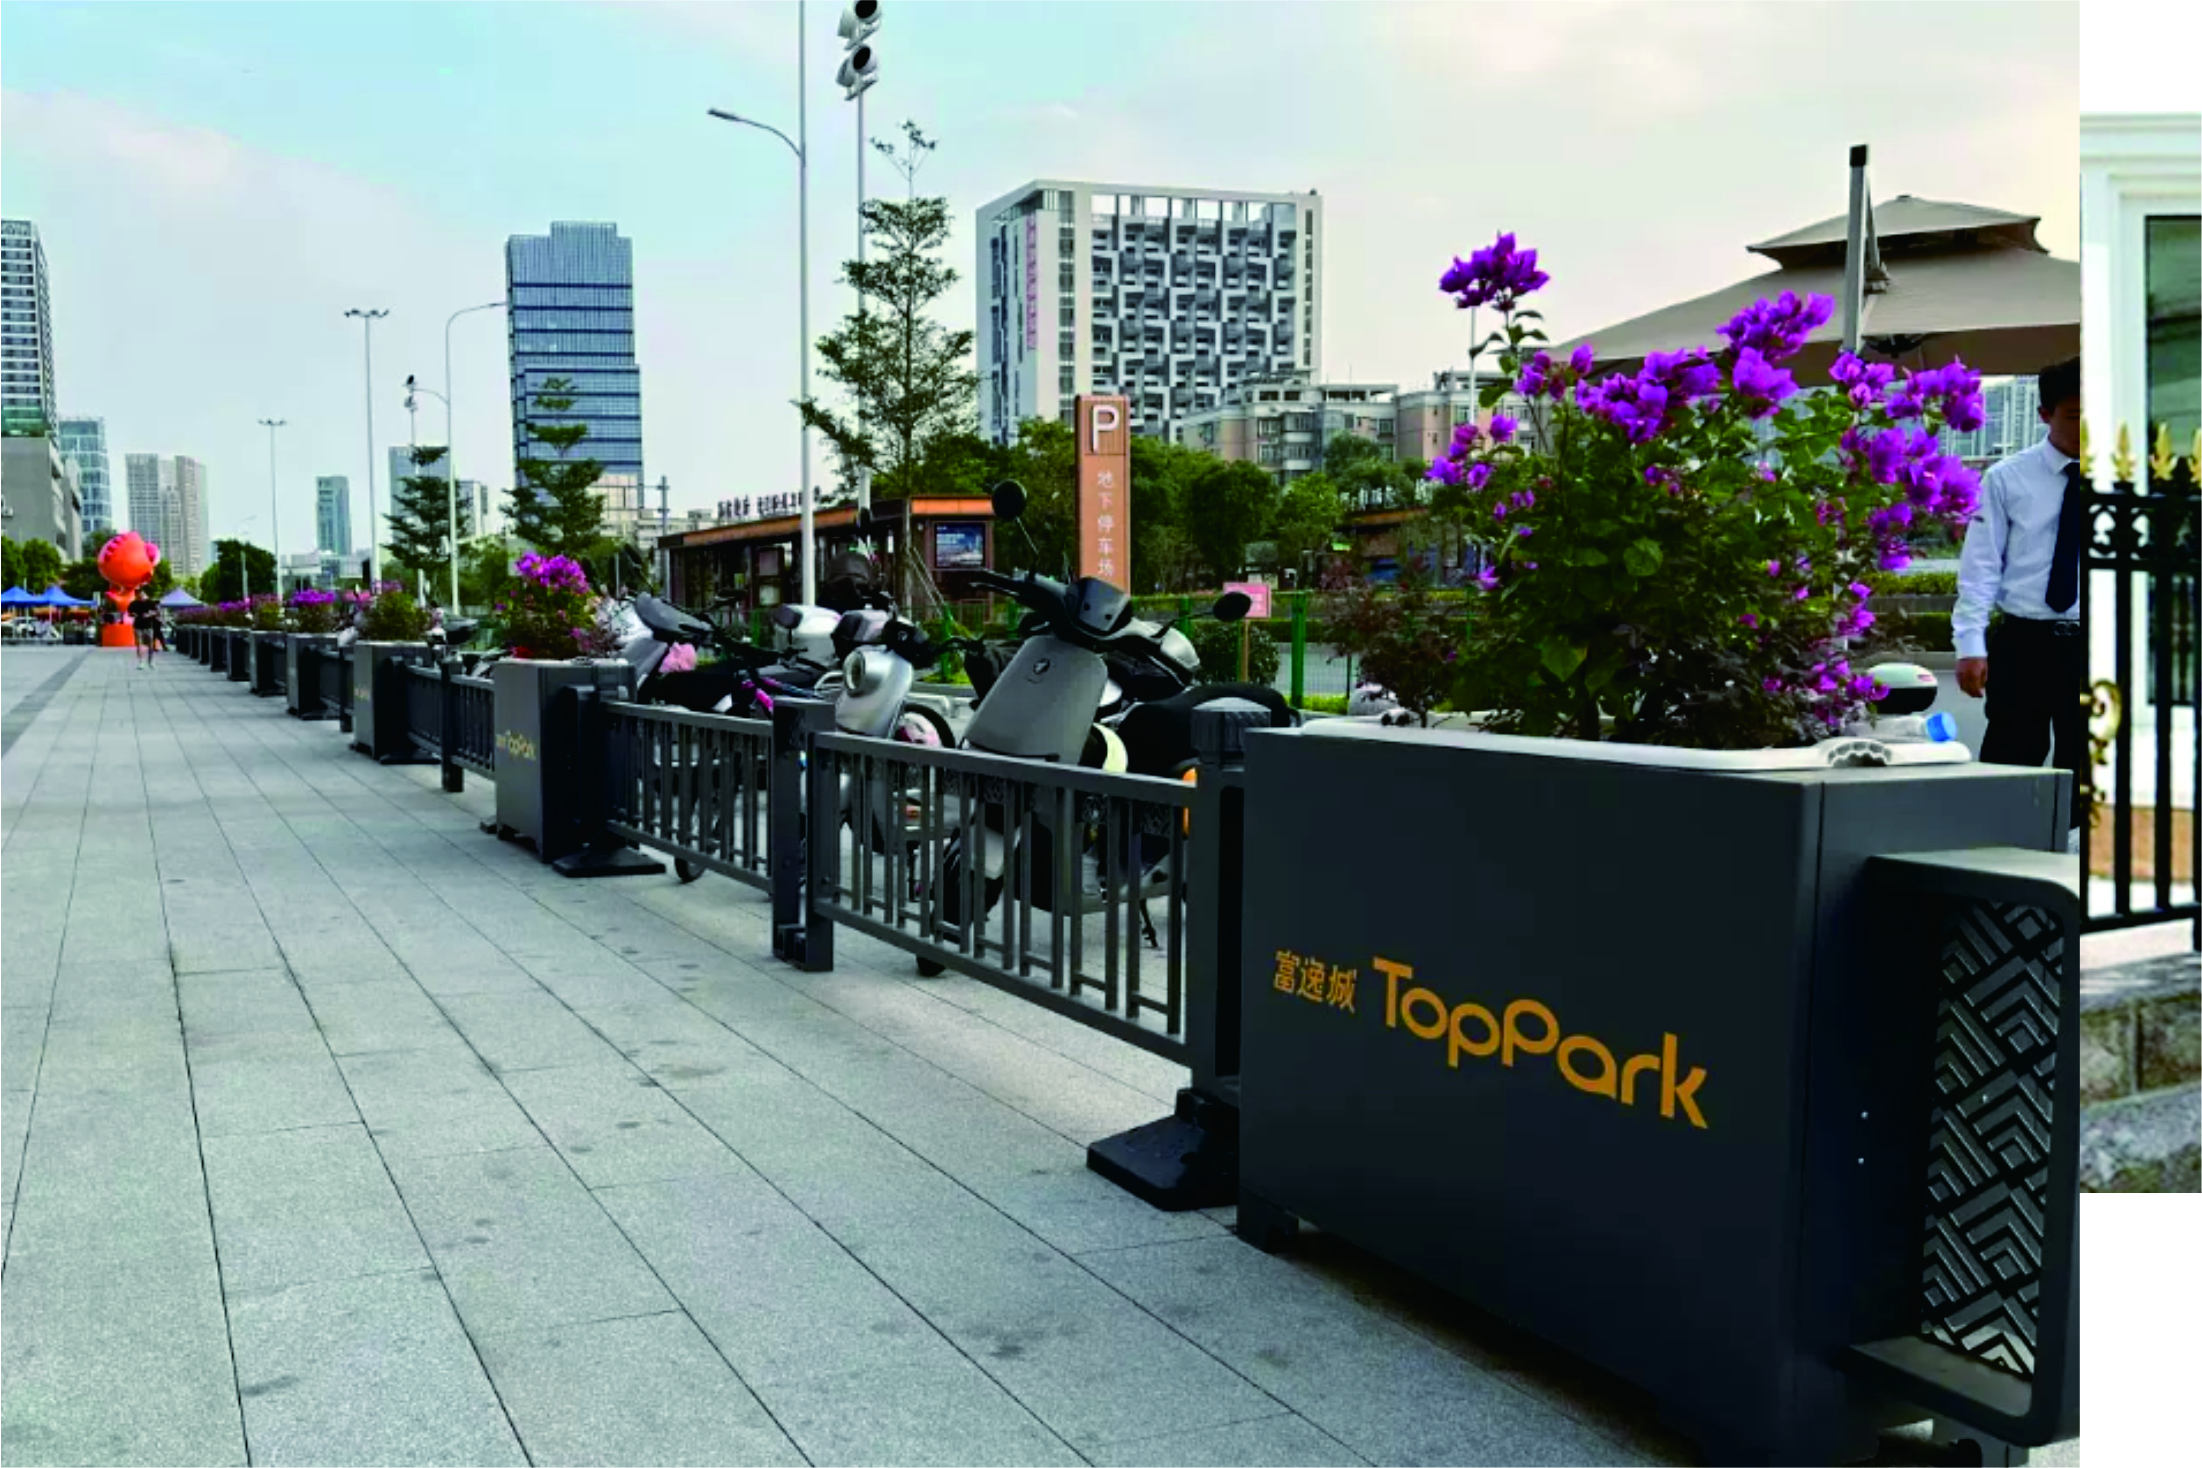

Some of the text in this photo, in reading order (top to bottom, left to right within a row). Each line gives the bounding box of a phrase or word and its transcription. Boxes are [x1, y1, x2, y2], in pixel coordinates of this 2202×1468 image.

[1092, 404, 1120, 454] P
[1097, 469, 1115, 577] 地下停车场
[1273, 949, 1708, 1129] 富逸城 TopPark
